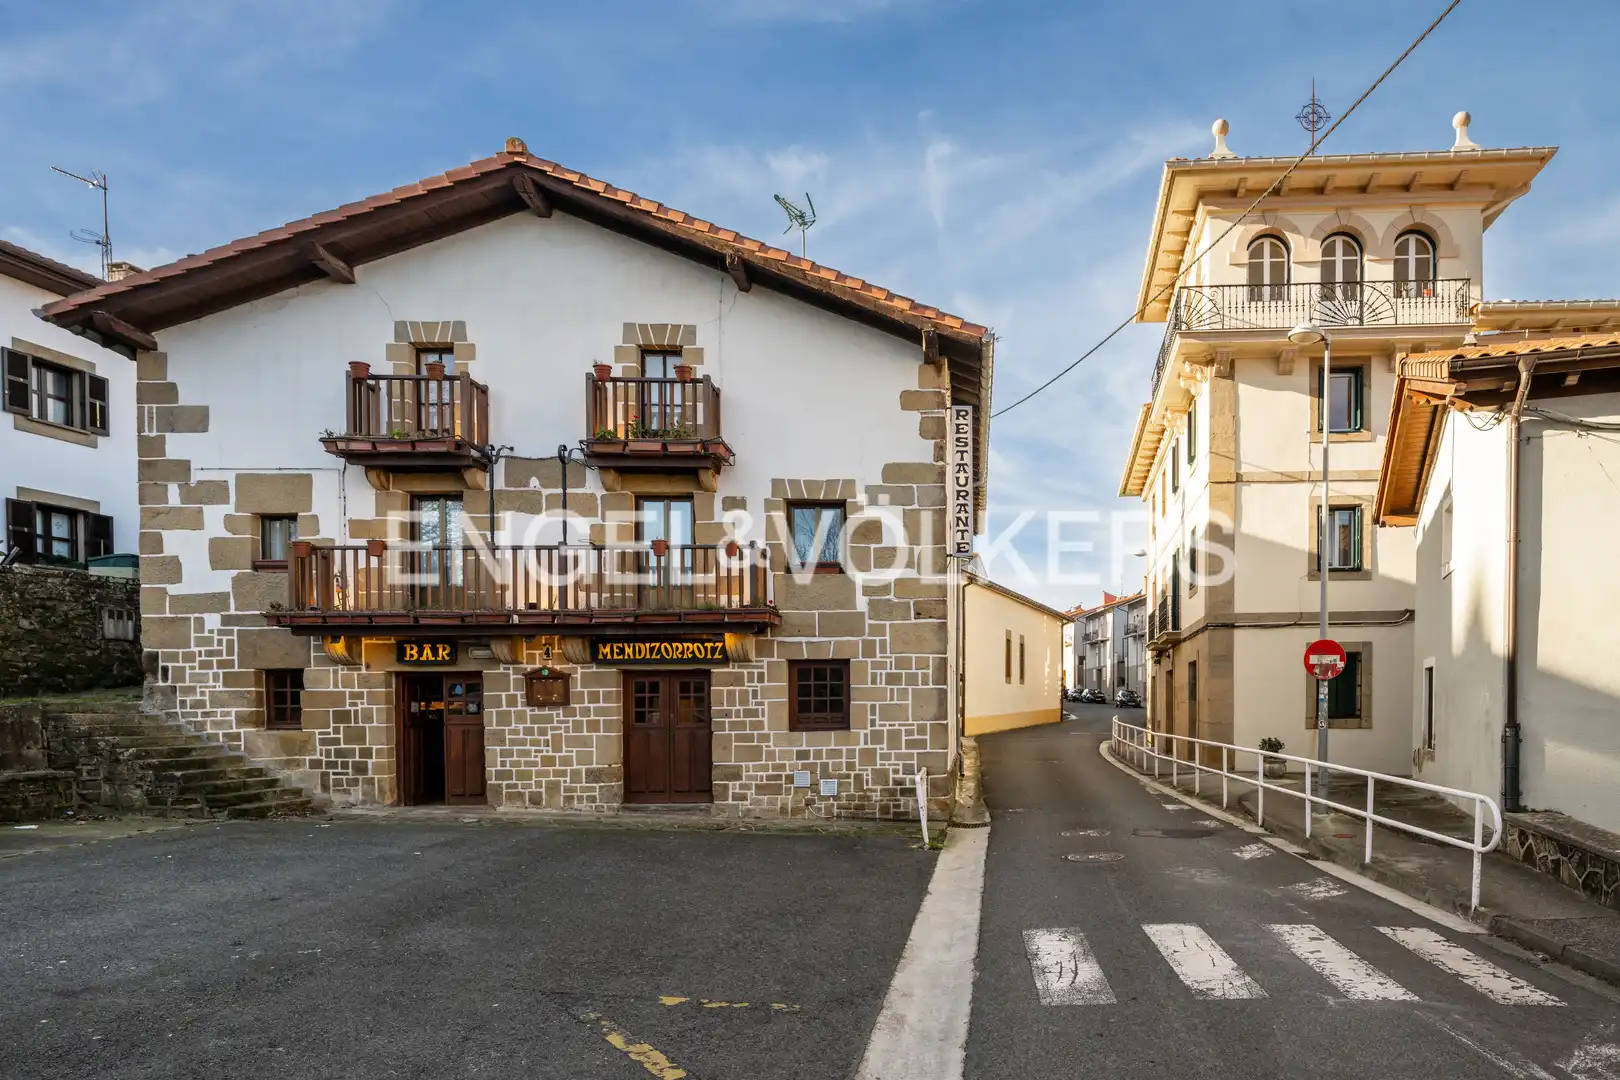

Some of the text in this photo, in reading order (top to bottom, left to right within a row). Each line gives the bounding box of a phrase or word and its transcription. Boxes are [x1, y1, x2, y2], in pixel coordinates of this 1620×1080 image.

[954, 408, 970, 554] RESTAURANTE
[403, 643, 451, 661] BAR
[543, 646, 551, 659] 4
[597, 642, 724, 660] MENDIZORROTZ
